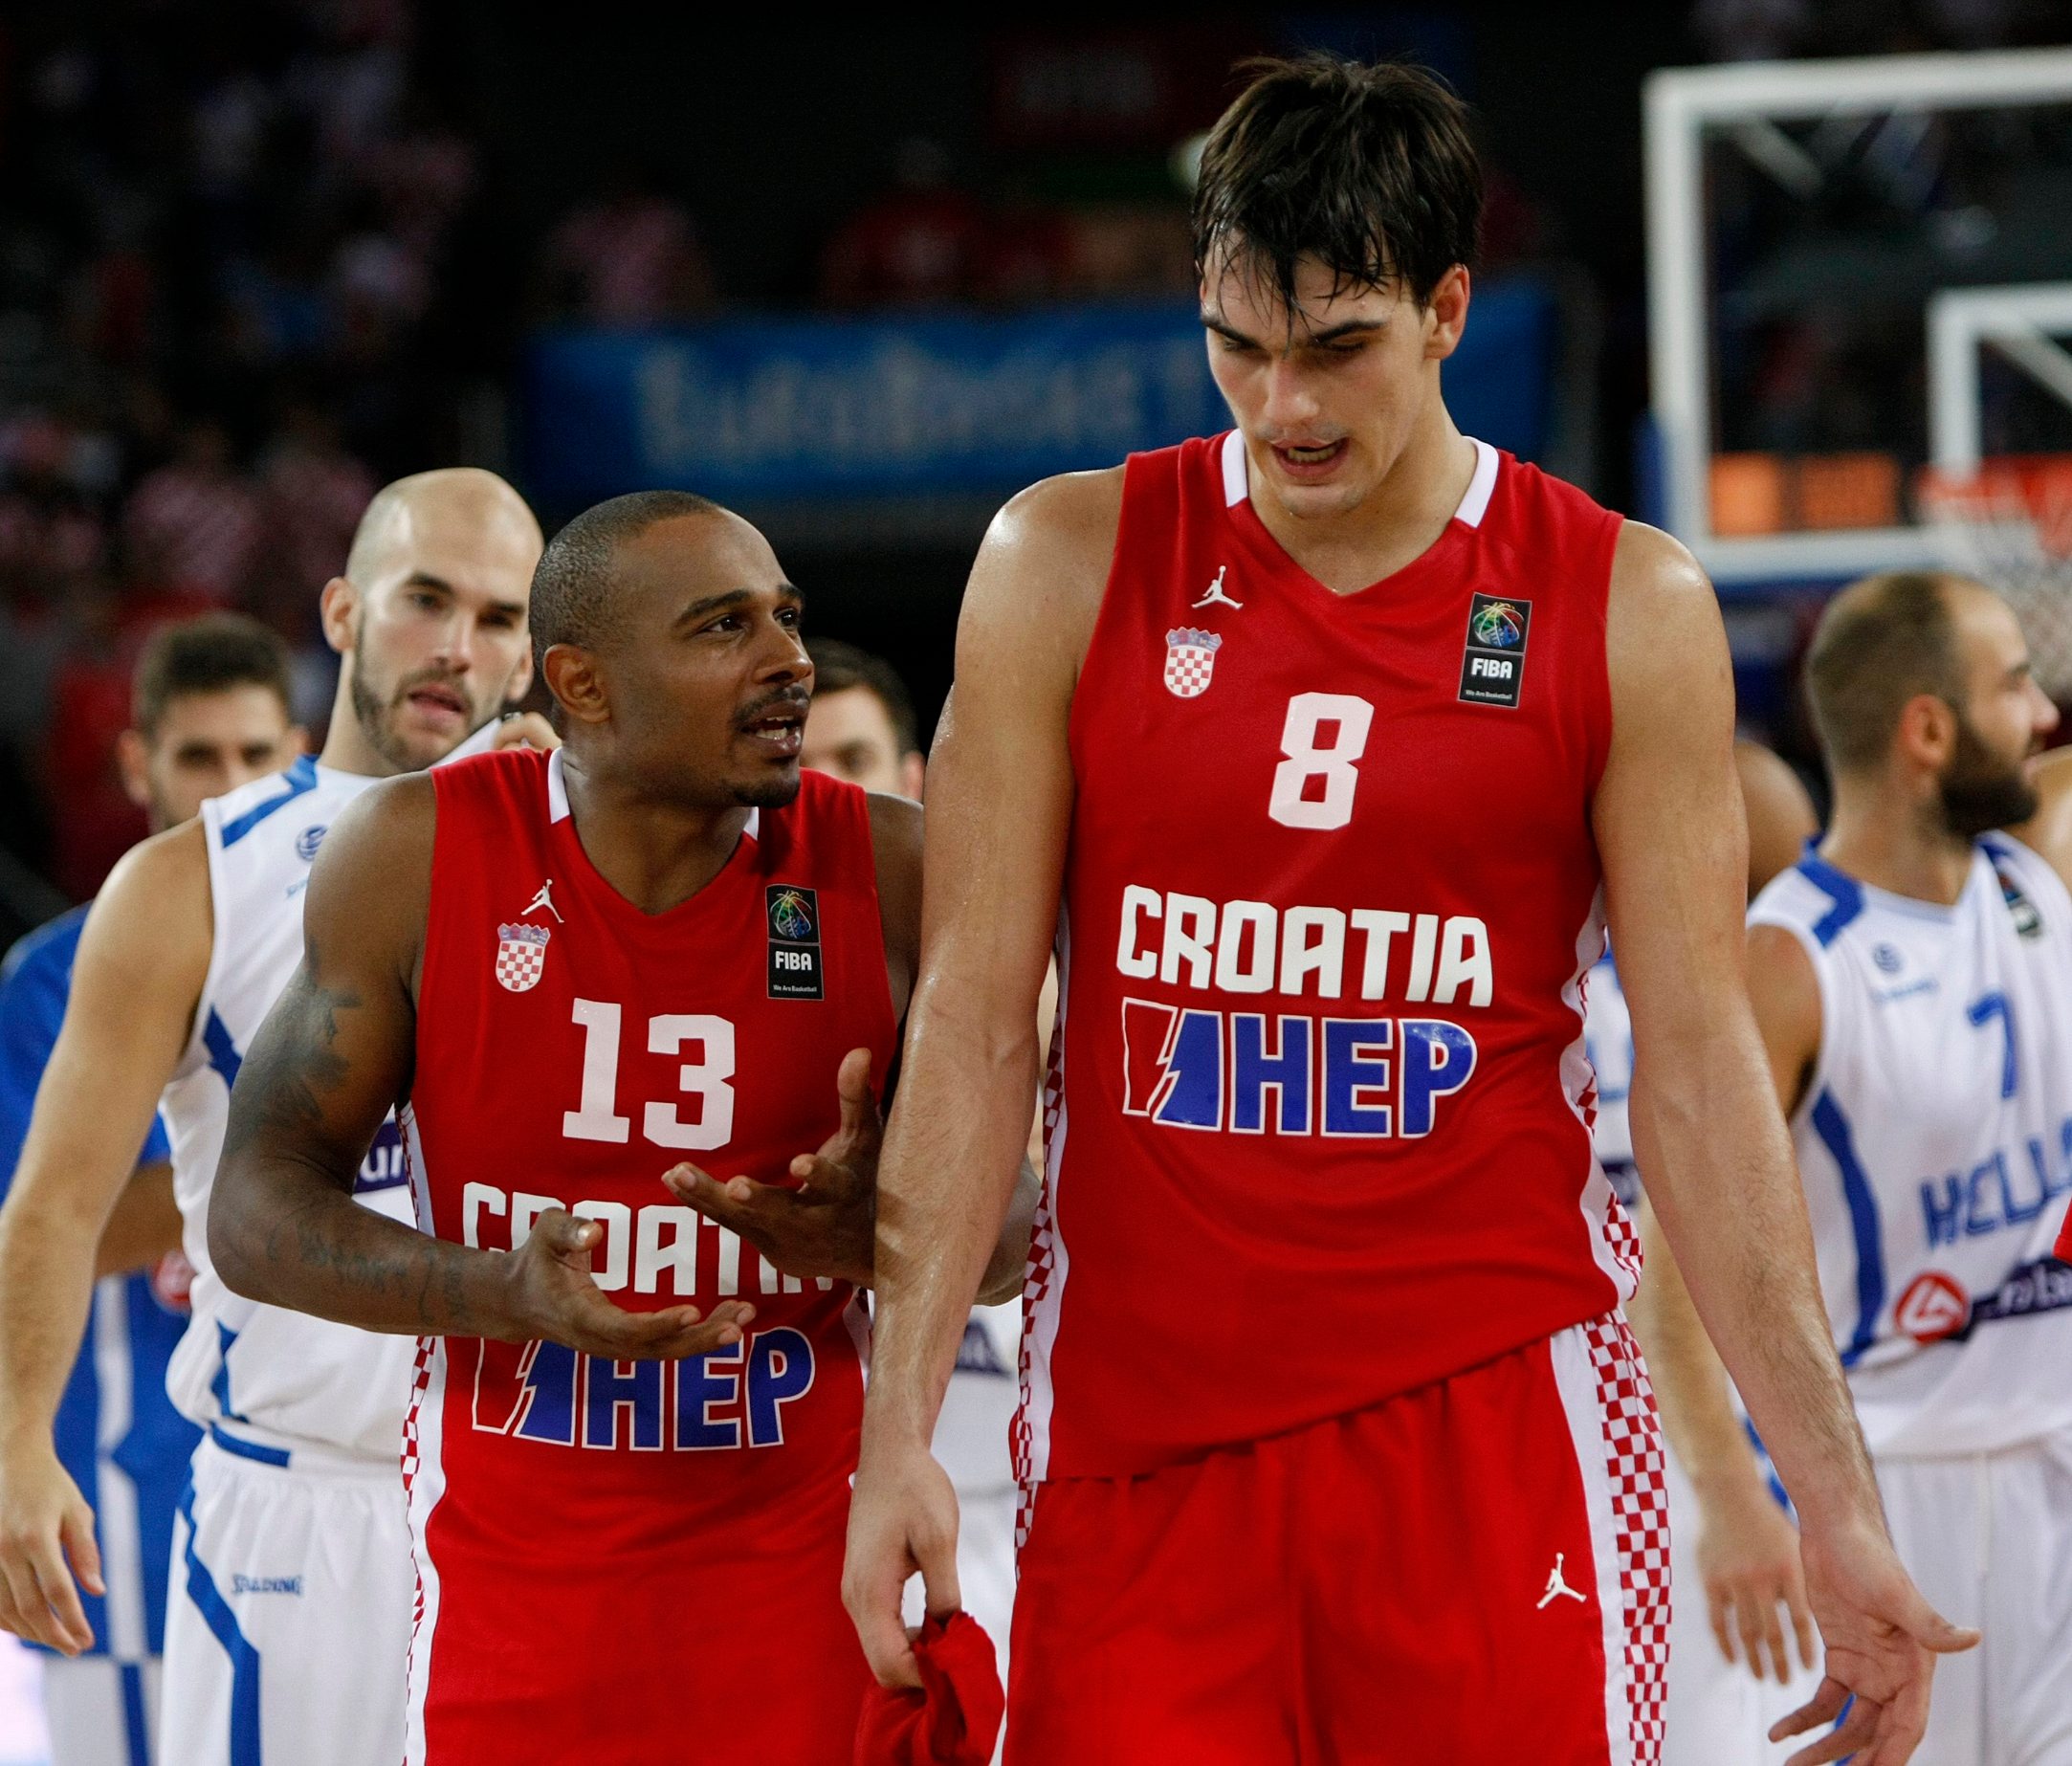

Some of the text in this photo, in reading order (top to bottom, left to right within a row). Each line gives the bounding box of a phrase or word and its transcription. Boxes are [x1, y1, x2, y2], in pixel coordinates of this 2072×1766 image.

[1471, 657, 1513, 679] FIBA
[1268, 692, 1375, 830] 8
[775, 950, 812, 971] FIBA
[1116, 884, 1494, 1007] CROATIA
[562, 997, 736, 1150] 13
[1229, 1012, 1478, 1138] HEP
[1967, 985, 2017, 1099] 7
[581, 1326, 816, 1452] HEP
